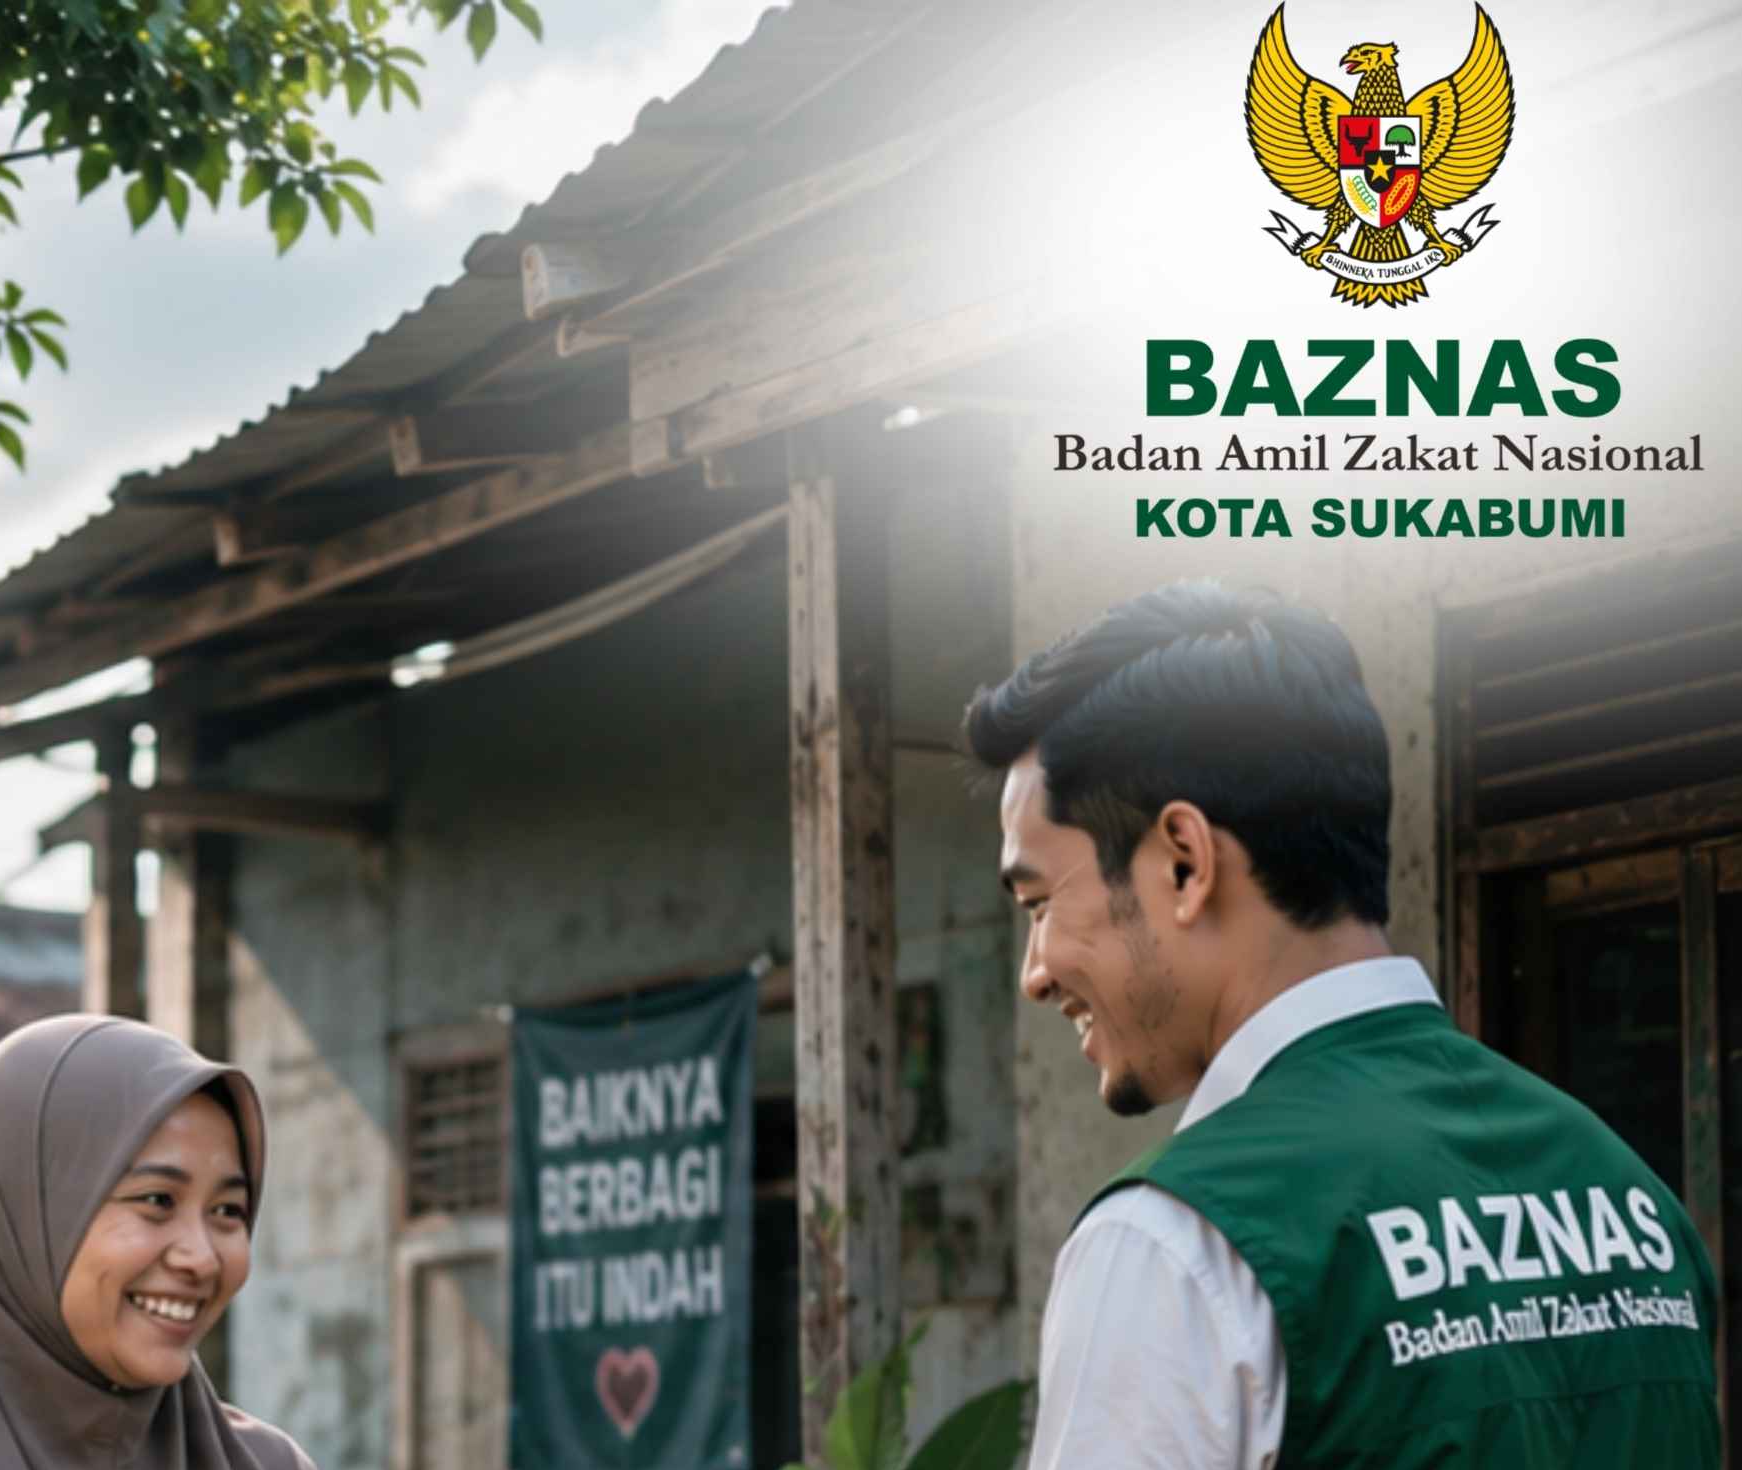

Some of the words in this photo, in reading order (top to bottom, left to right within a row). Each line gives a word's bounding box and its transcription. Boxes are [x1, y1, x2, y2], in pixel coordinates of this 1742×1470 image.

[539, 1056, 723, 1149] BAIKNYA
[539, 1146, 722, 1236] BERBAGI
[535, 1256, 595, 1333] ITU
[602, 1244, 723, 1327] INDAH
[1366, 1186, 1675, 1301] BAZNAS
[1385, 1309, 1488, 1367] Badan
